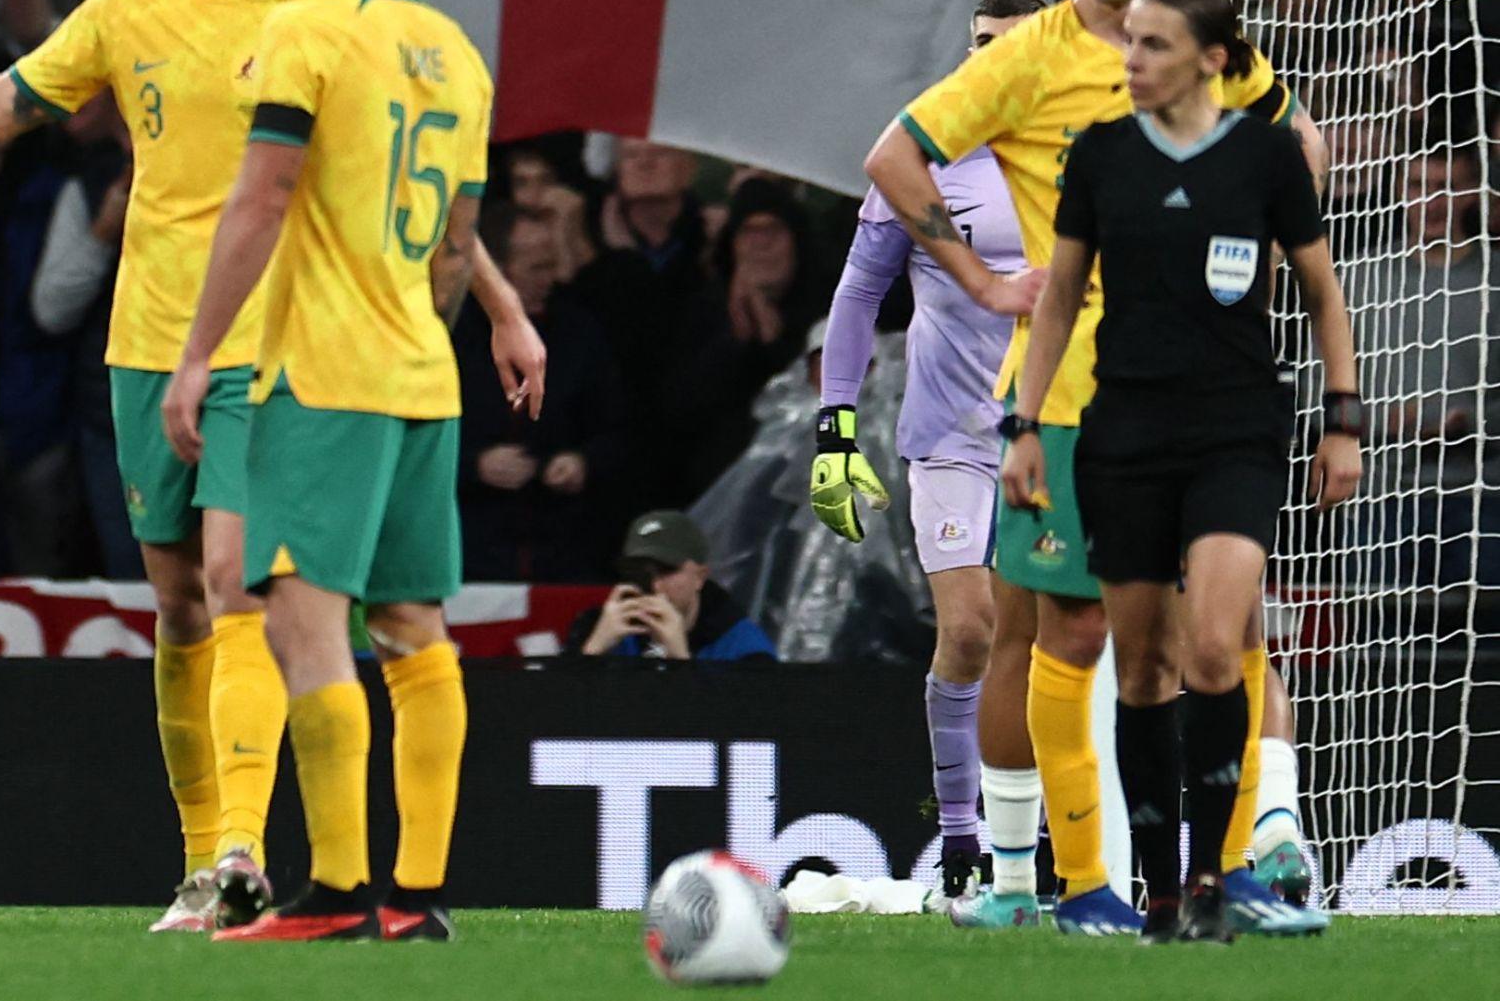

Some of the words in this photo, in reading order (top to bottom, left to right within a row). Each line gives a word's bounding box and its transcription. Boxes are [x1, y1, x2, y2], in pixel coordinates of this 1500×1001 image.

[140, 82, 163, 139] 3
[384, 101, 459, 260] 15
[1214, 244, 1251, 263] FIFA
[530, 739, 1000, 912] Th
